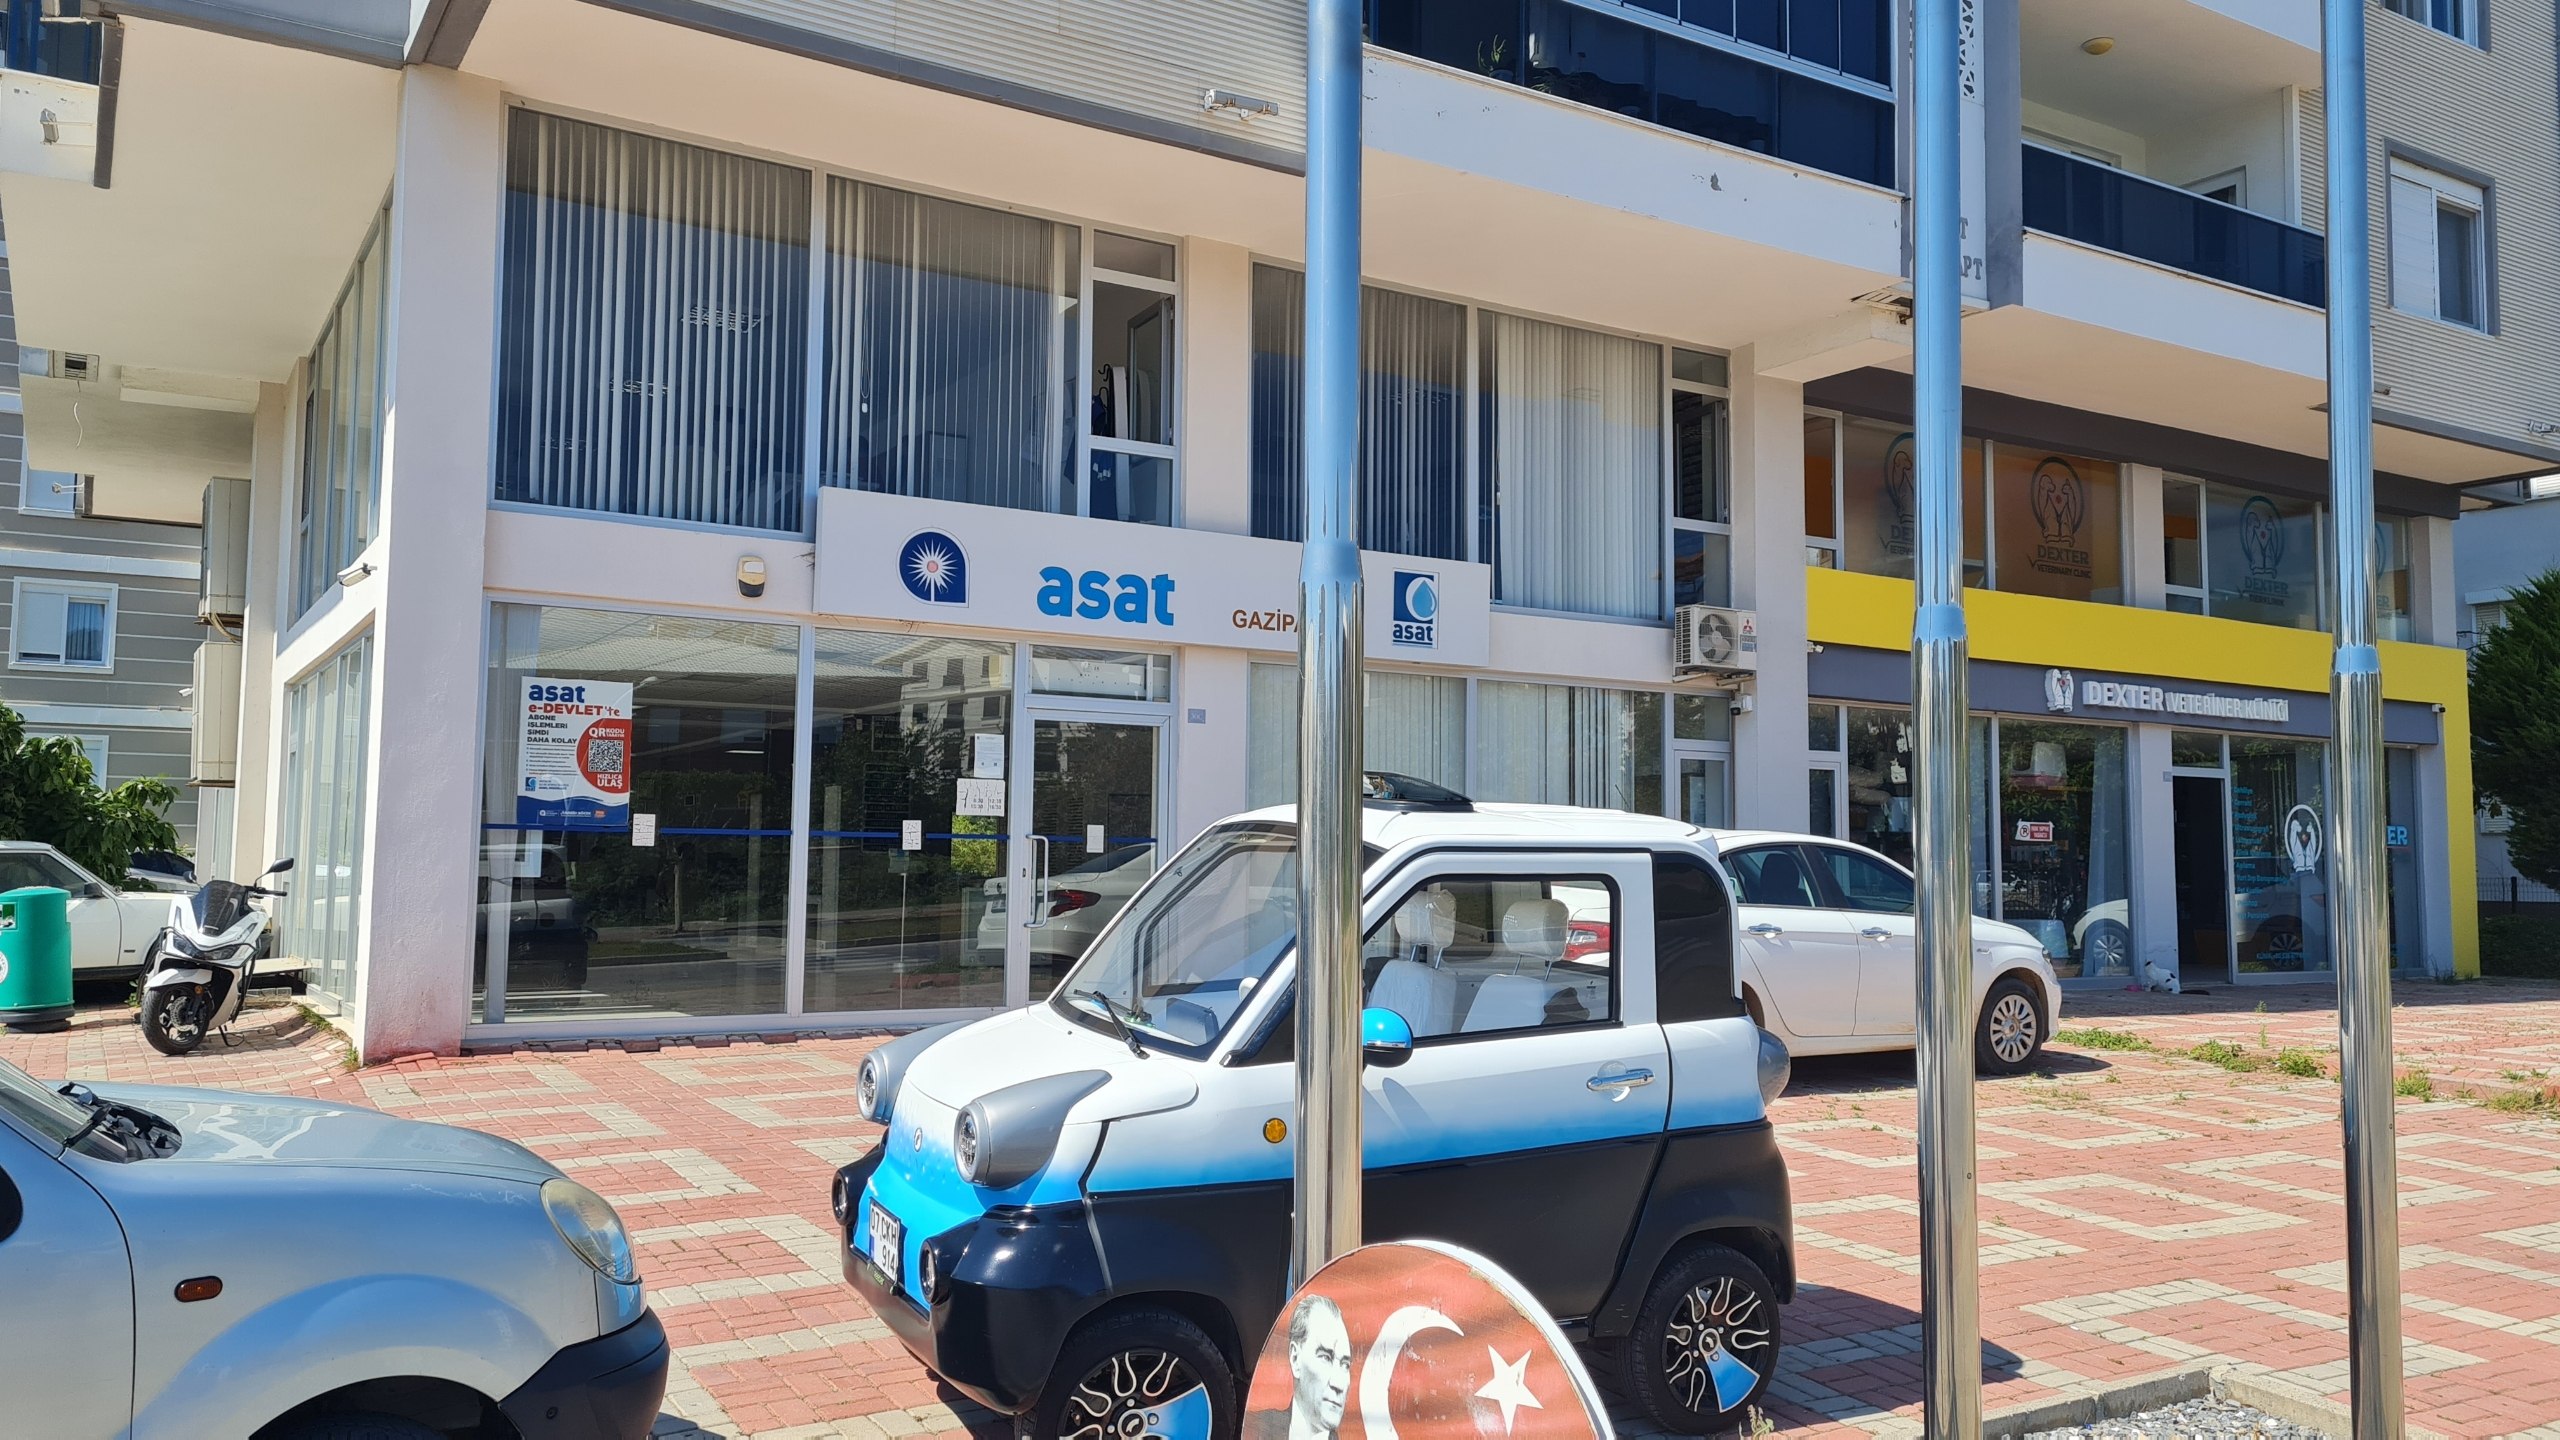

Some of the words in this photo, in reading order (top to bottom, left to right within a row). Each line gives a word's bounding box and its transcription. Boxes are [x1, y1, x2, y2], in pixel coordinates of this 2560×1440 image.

[2037, 544, 2089, 565] DEXTER
[2244, 575, 2289, 595] DEXTER
[1036, 566, 1176, 627] asat
[1392, 623, 1433, 642] asat
[528, 684, 586, 703] asat
[2082, 681, 2164, 712] DEXTER
[551, 737, 577, 745] KOLAY
[588, 727, 606, 738] QR
[597, 779, 623, 789] ULAŞ
[881, 1216, 897, 1249] CKH
[882, 1244, 896, 1277] 914
